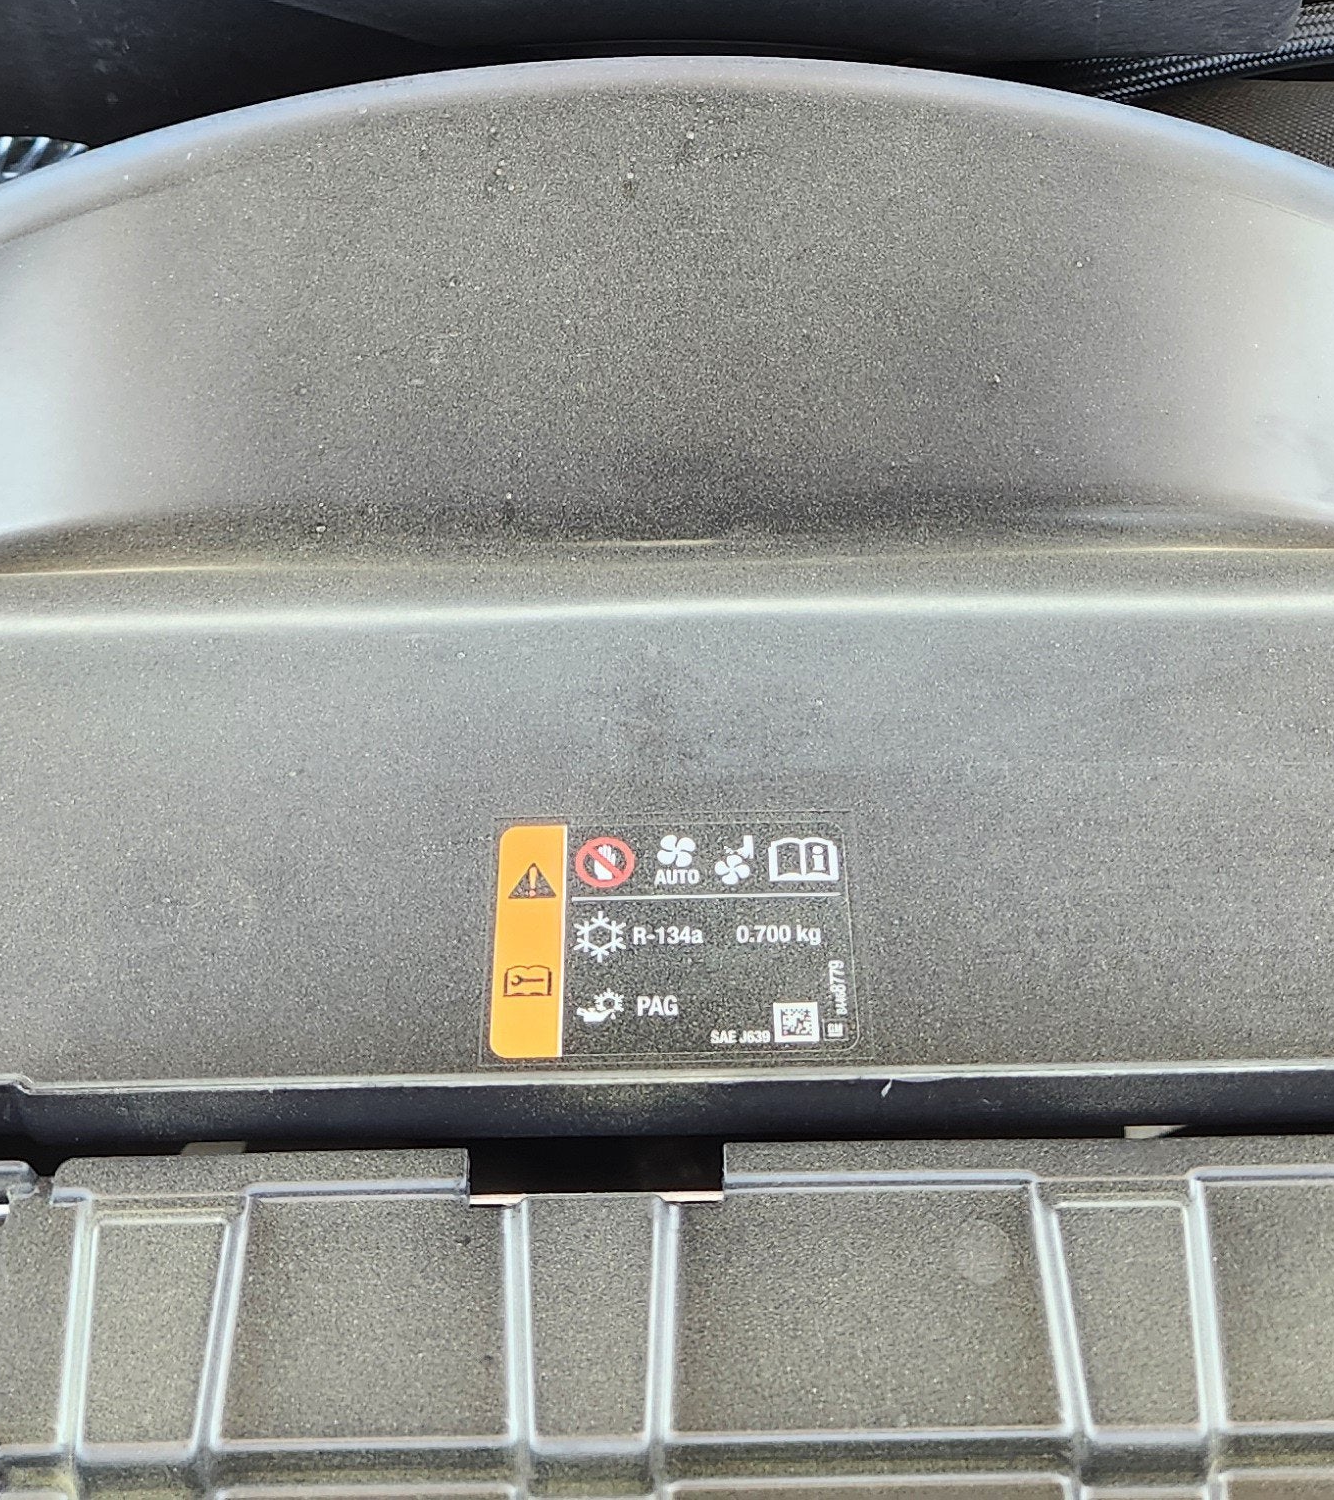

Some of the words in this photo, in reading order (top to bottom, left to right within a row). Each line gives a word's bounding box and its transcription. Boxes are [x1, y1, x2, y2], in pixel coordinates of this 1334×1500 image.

[654, 868, 701, 886] AUTO
[633, 924, 704, 946] R-134a
[735, 924, 792, 945] 0.700
[796, 923, 822, 946] kg
[637, 994, 680, 1017] PAG
[710, 1029, 738, 1044] SAE
[738, 1029, 771, 1044] J639
